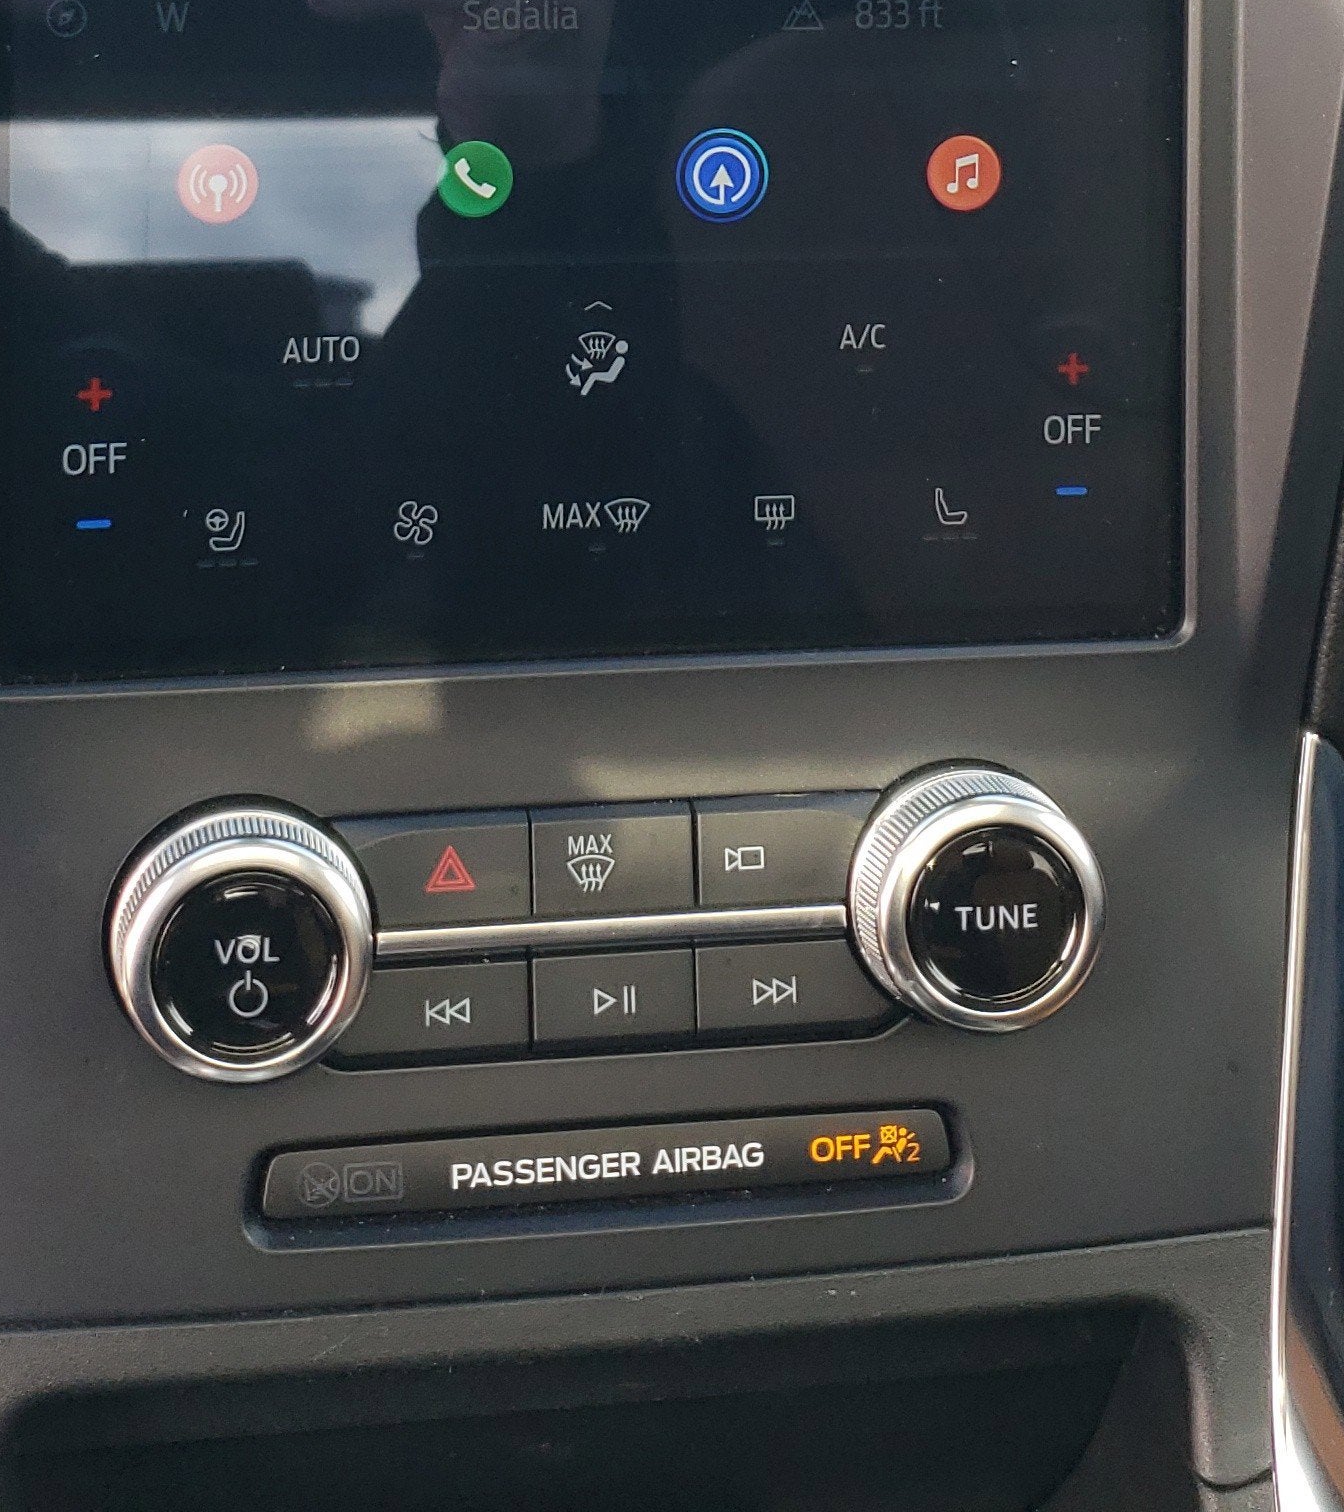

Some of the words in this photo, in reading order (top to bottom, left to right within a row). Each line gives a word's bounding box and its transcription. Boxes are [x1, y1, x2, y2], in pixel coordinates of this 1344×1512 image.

[155, 1, 190, 33] W
[462, 0, 579, 31] Sedalia
[855, 0, 912, 29] 833
[917, 0, 944, 29] ft
[282, 335, 361, 364] AUTO
[839, 323, 887, 350] A/C
[1042, 414, 1102, 446] OFF
[61, 441, 129, 476] OFF
[542, 501, 602, 530] MAX
[567, 833, 614, 856] MAX
[953, 902, 1040, 933] TUNE
[215, 936, 281, 966] VOL
[348, 1166, 401, 1195] ON
[451, 1150, 642, 1191] PASSENGER
[652, 1141, 765, 1176] AIRBAG
[810, 1133, 872, 1163] OFF
